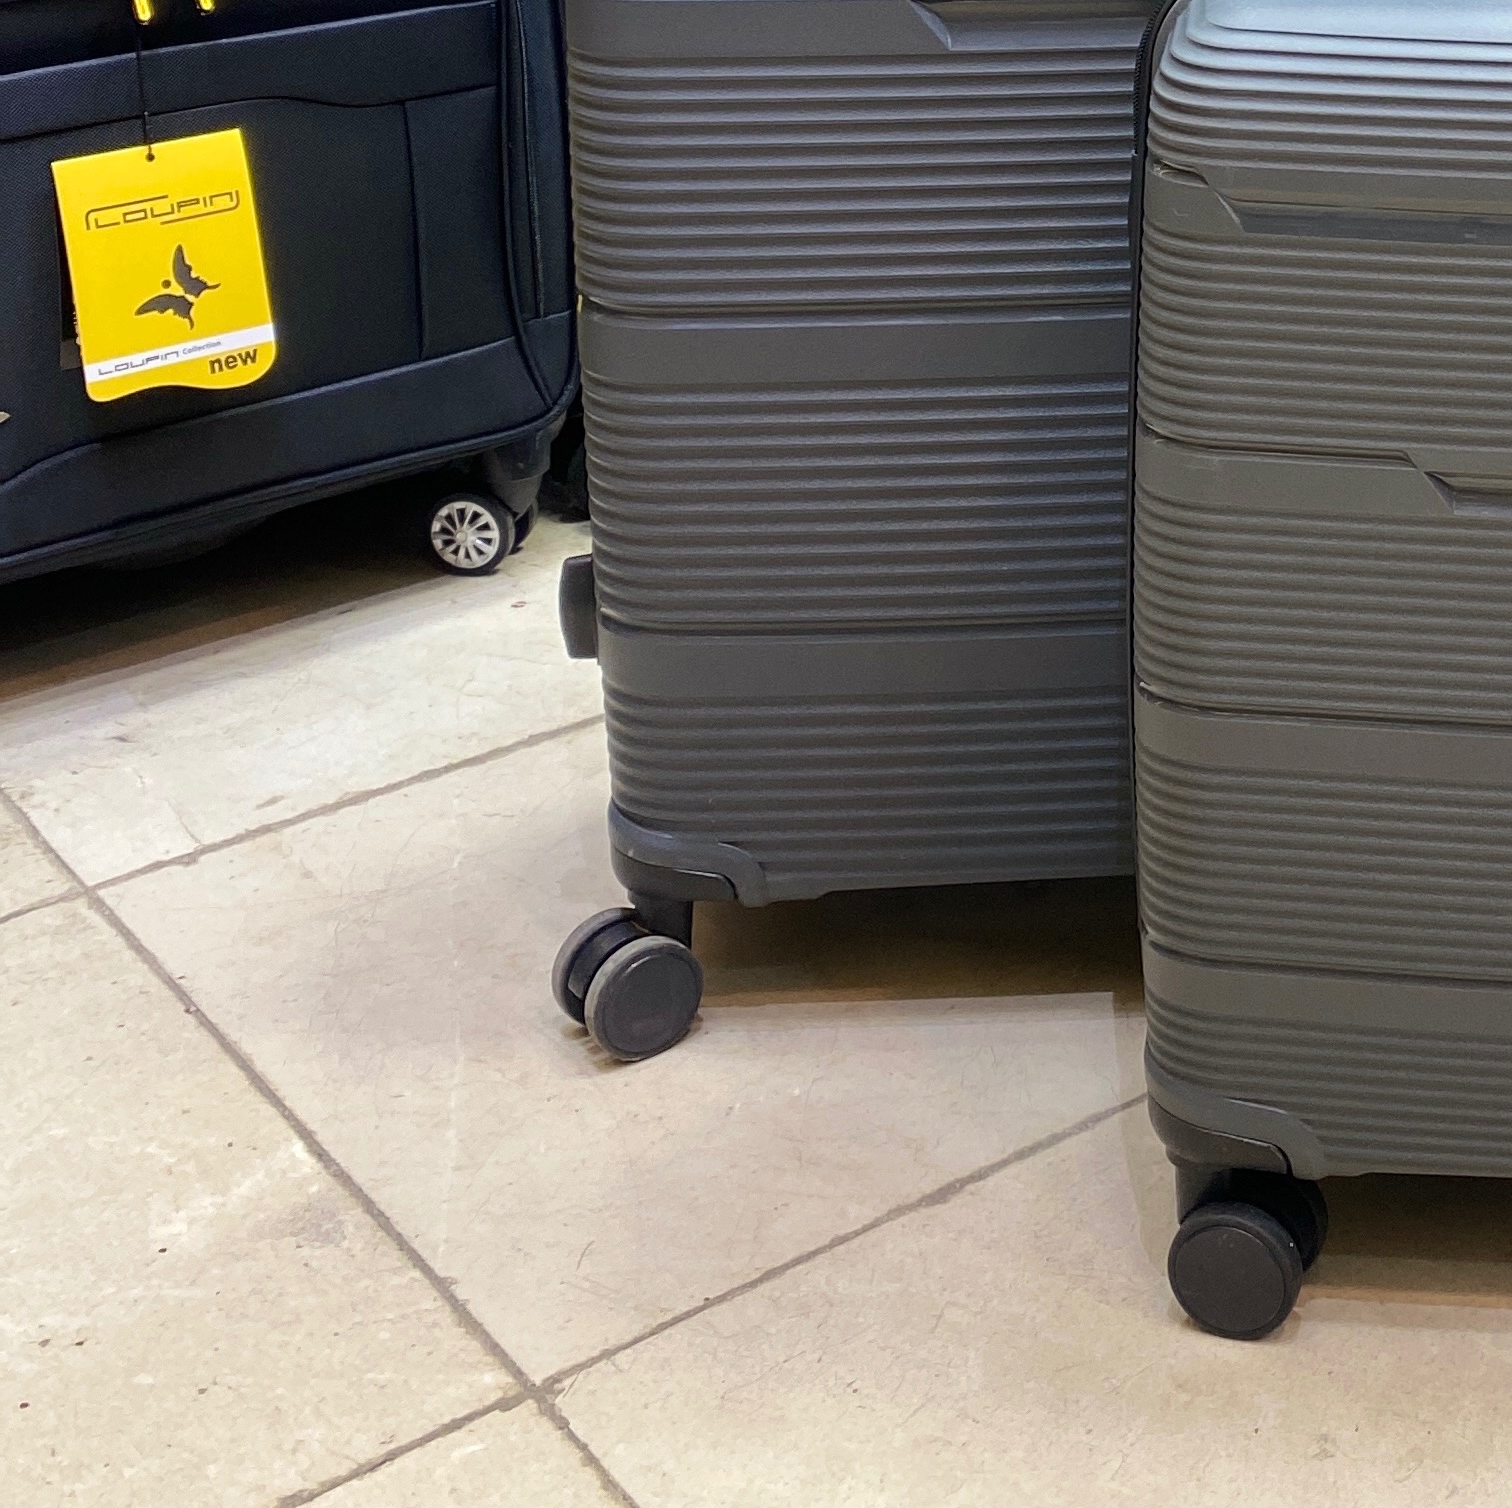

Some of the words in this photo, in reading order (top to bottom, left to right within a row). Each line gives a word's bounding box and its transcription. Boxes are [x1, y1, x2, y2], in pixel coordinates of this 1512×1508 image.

[94, 191, 236, 230] LOUPIN
[98, 351, 179, 376] LOUPIN
[209, 348, 258, 374] new
